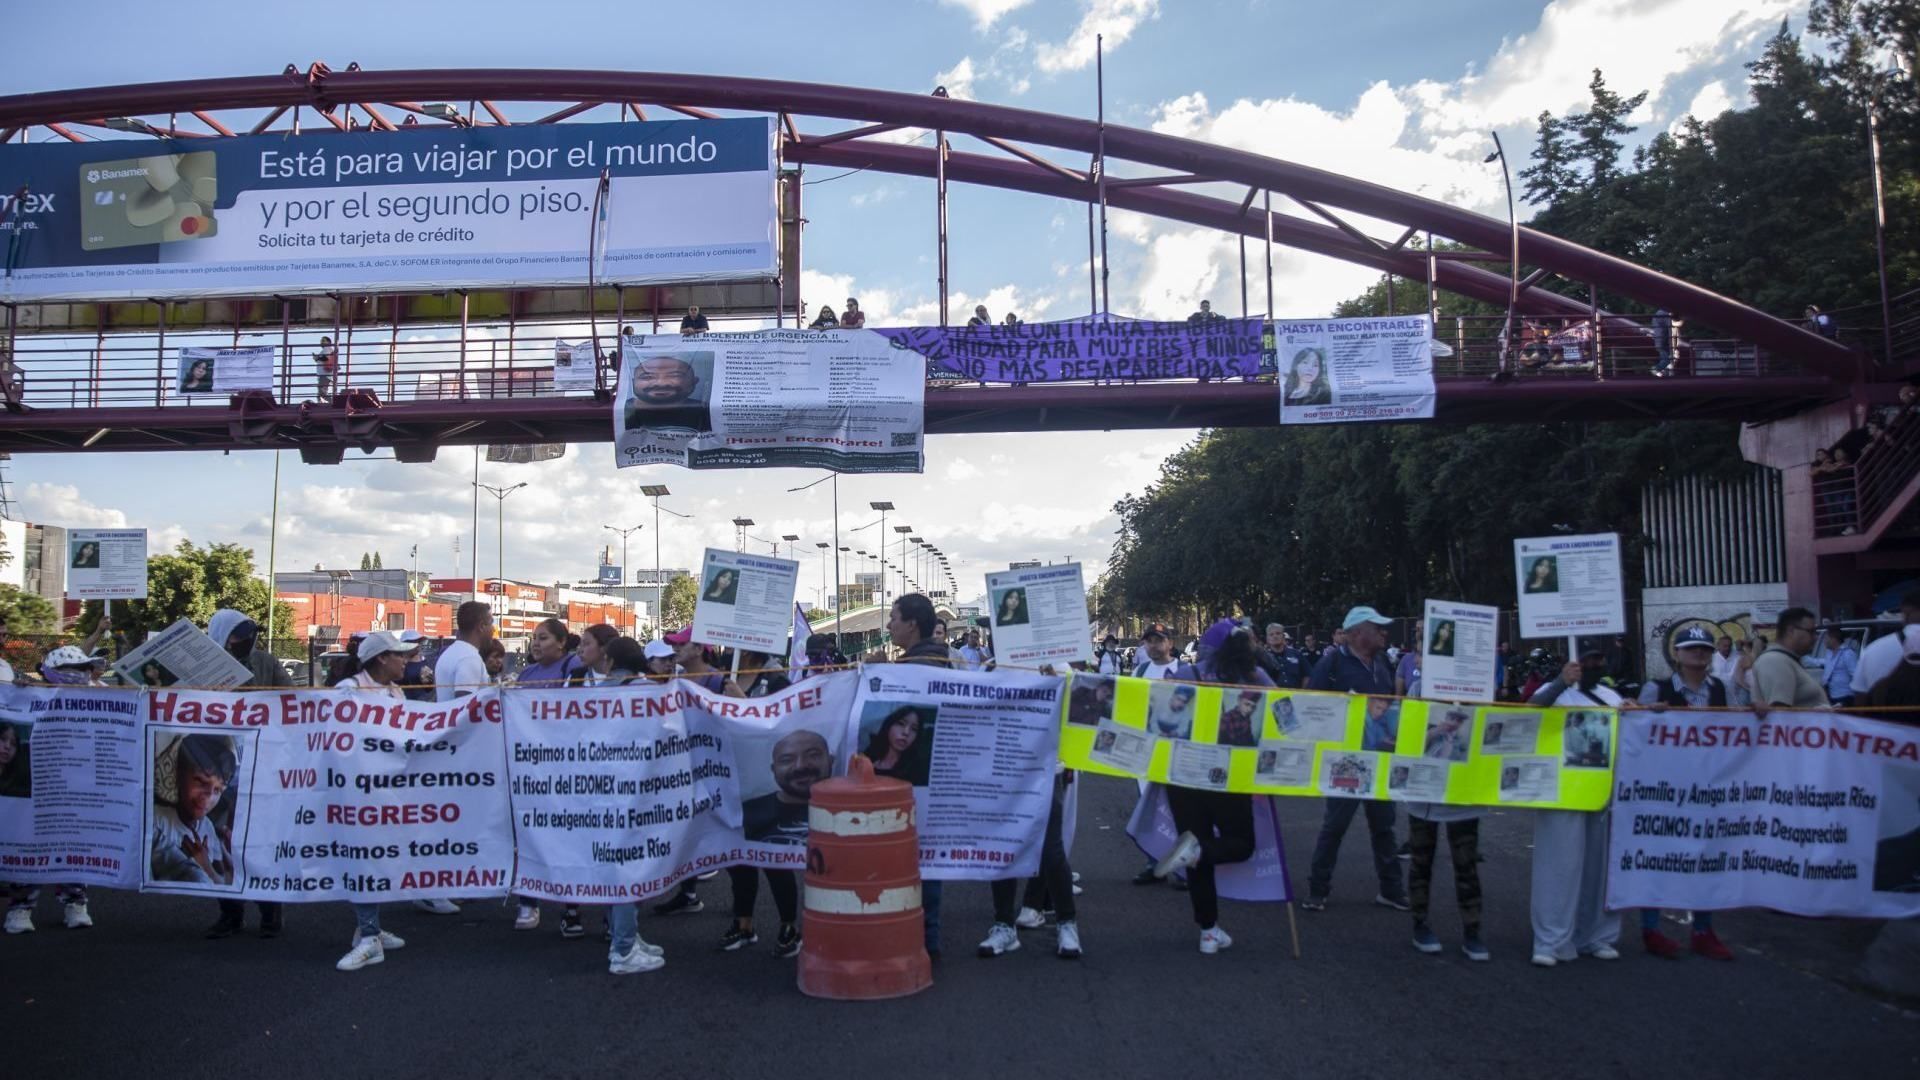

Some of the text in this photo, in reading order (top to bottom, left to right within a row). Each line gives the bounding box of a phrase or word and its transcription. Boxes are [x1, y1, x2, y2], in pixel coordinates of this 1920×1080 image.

[260, 135, 717, 182] Está para viajar por el mundo
[101, 167, 149, 179] Banamex
[260, 186, 590, 228] y por el segundo piso.
[258, 226, 474, 248] Solicita tu tarjeta de crédito
[644, 252, 654, 260] de
[656, 249, 705, 259] contratación
[713, 246, 756, 257] comisiones
[72, 270, 84, 278] Las
[86, 269, 115, 279] Tarjetas
[117, 268, 126, 276] de
[127, 267, 155, 277] Crédito
[156, 266, 188, 275] Banamex
[205, 265, 242, 274] productos
[243, 264, 275, 272] emitidos
[276, 265, 289, 273] por
[290, 262, 320, 272] Tarjetas
[400, 258, 429, 267] SOFOM
[442, 256, 480, 267] integrante
[482, 256, 494, 265] del
[495, 256, 519, 266] Grupo
[520, 255, 559, 264] Financiero
[753, 332, 768, 340] DE
[771, 331, 828, 340] URGENCIA
[1279, 320, 1424, 335] ¡HASTA ENCONTRARLE!
[1026, 338, 1079, 359] PARA
[1088, 337, 1182, 359] MUJERES
[1186, 336, 1200, 358] Y
[785, 435, 883, 448] Encontrarte!
[531, 686, 823, 721] !HASTA ENCONTRARTE!
[928, 680, 970, 698] ¡HASTA
[972, 683, 1057, 702] ENCONTRARLE!
[150, 690, 502, 731] Hasta Encontrarte
[306, 731, 457, 755] VIVO se fue,
[1648, 723, 1750, 747] !HASTA
[514, 742, 565, 764] Exigimos
[567, 748, 575, 762] a
[577, 741, 586, 761] la
[588, 738, 652, 762] Gobernadora
[279, 768, 496, 794] VIVO lo queremos
[512, 768, 691, 796] al fiscal del EDOMEX una respuesta
[1618, 781, 1630, 802] La
[1632, 779, 1675, 802] Familia
[1677, 788, 1686, 807] y
[1688, 782, 1726, 808] Amigos
[1729, 782, 1740, 802] de
[1743, 780, 1767, 802] Juan
[1848, 785, 1877, 809] Ríos
[295, 803, 461, 827] de REGRESO
[523, 799, 690, 832] a las exigencias de la Familia de
[1633, 814, 1691, 838] EXIGIMOS
[1693, 823, 1701, 838] a
[1703, 818, 1713, 839] la
[1715, 816, 1751, 839] Fiscalía
[1753, 814, 1767, 836] de
[274, 838, 479, 863] ¡No estamos todos
[591, 836, 671, 866] Velázquez Ríos
[520, 876, 542, 893] POR
[544, 880, 573, 898] CADA
[575, 883, 628, 899] FAMILIA
[630, 880, 661, 899] QUE
[696, 850, 728, 871] SOLA
[730, 848, 745, 863] EL
[746, 848, 807, 866] SISTEMA
[1620, 849, 1632, 871] de
[1634, 849, 1697, 874] Cuautitlán
[1728, 857, 1740, 872] su
[1741, 849, 1799, 879] Búsqueda
[249, 865, 506, 893] nos hace falta ADRIÁN!
